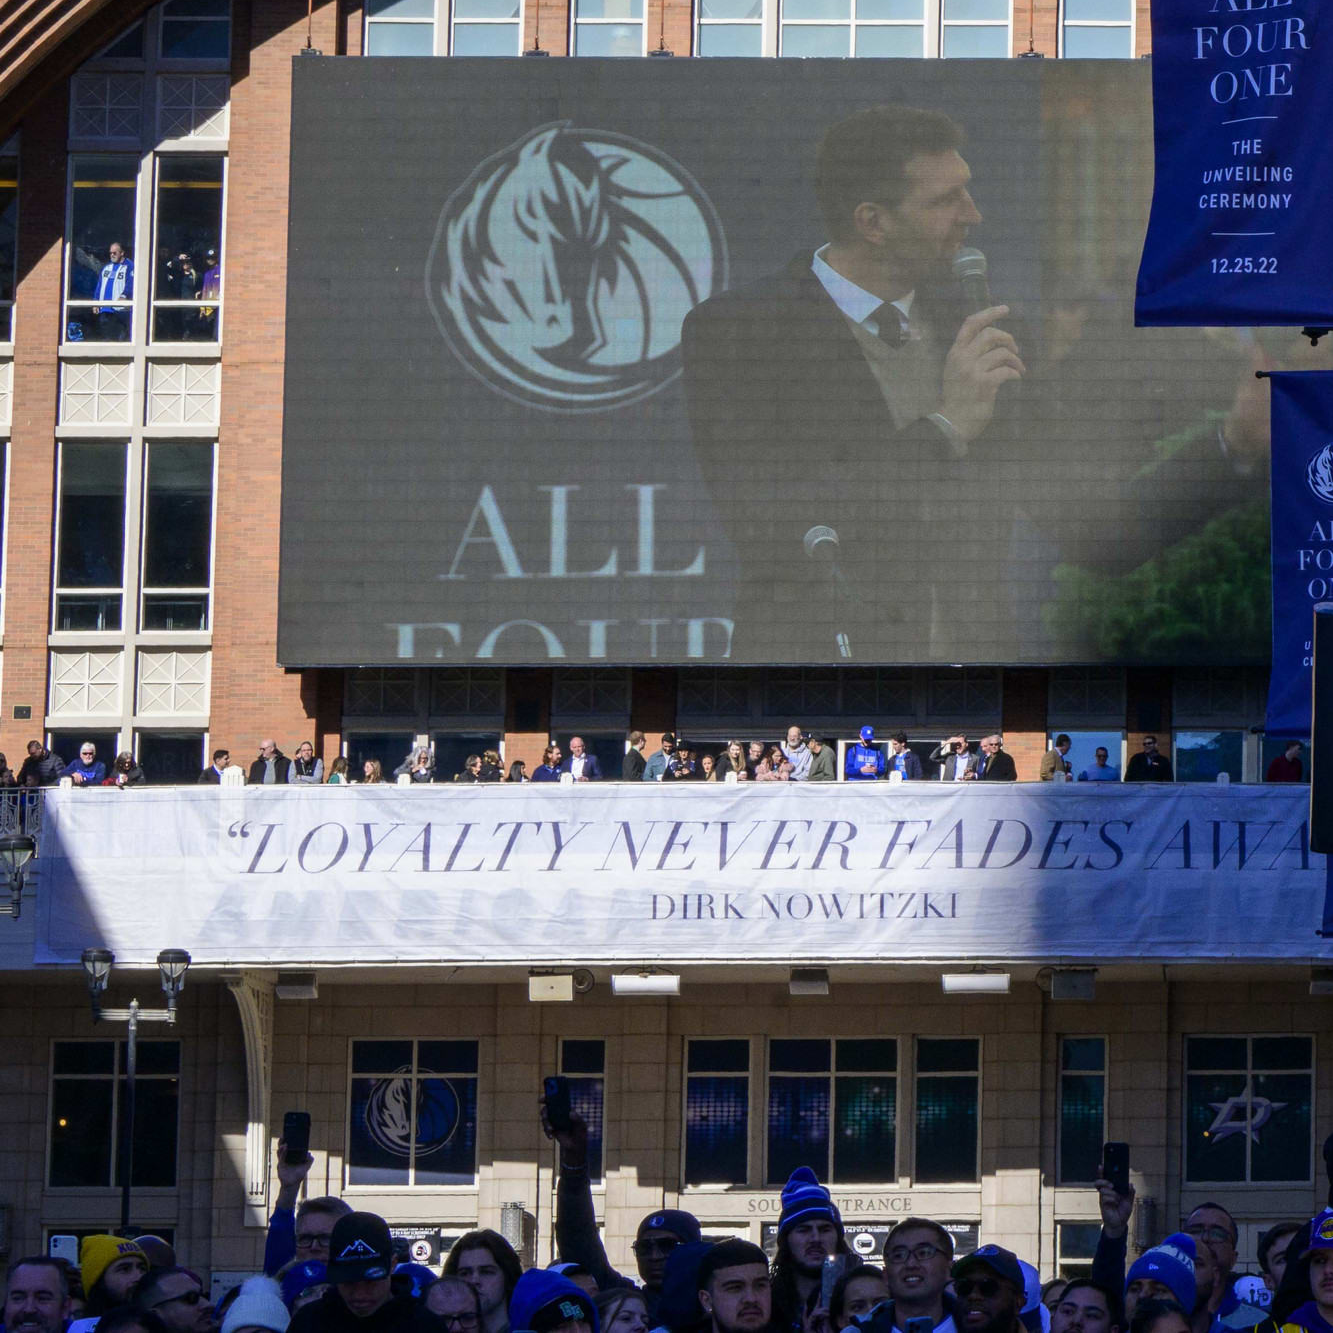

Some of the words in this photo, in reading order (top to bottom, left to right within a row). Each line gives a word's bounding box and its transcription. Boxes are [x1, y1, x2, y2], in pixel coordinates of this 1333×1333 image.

[1193, 17, 1311, 60] FOUR
[1209, 63, 1293, 105] ONE
[1231, 139, 1262, 156] THE
[1203, 166, 1294, 185] UNVEILING
[1199, 193, 1293, 210] CEREMONY
[1210, 258, 1278, 275] 12.25.22
[439, 483, 706, 579] ALL
[227, 819, 593, 874] “LOYALTY
[595, 820, 857, 872] NEVER
[870, 818, 1133, 872] FADES
[1143, 819, 1326, 872] AWA
[648, 892, 745, 921] DIRK
[757, 891, 960, 920] NOWITZKI
[748, 1199, 781, 1212] SOU
[837, 1197, 912, 1212] TRANCE
